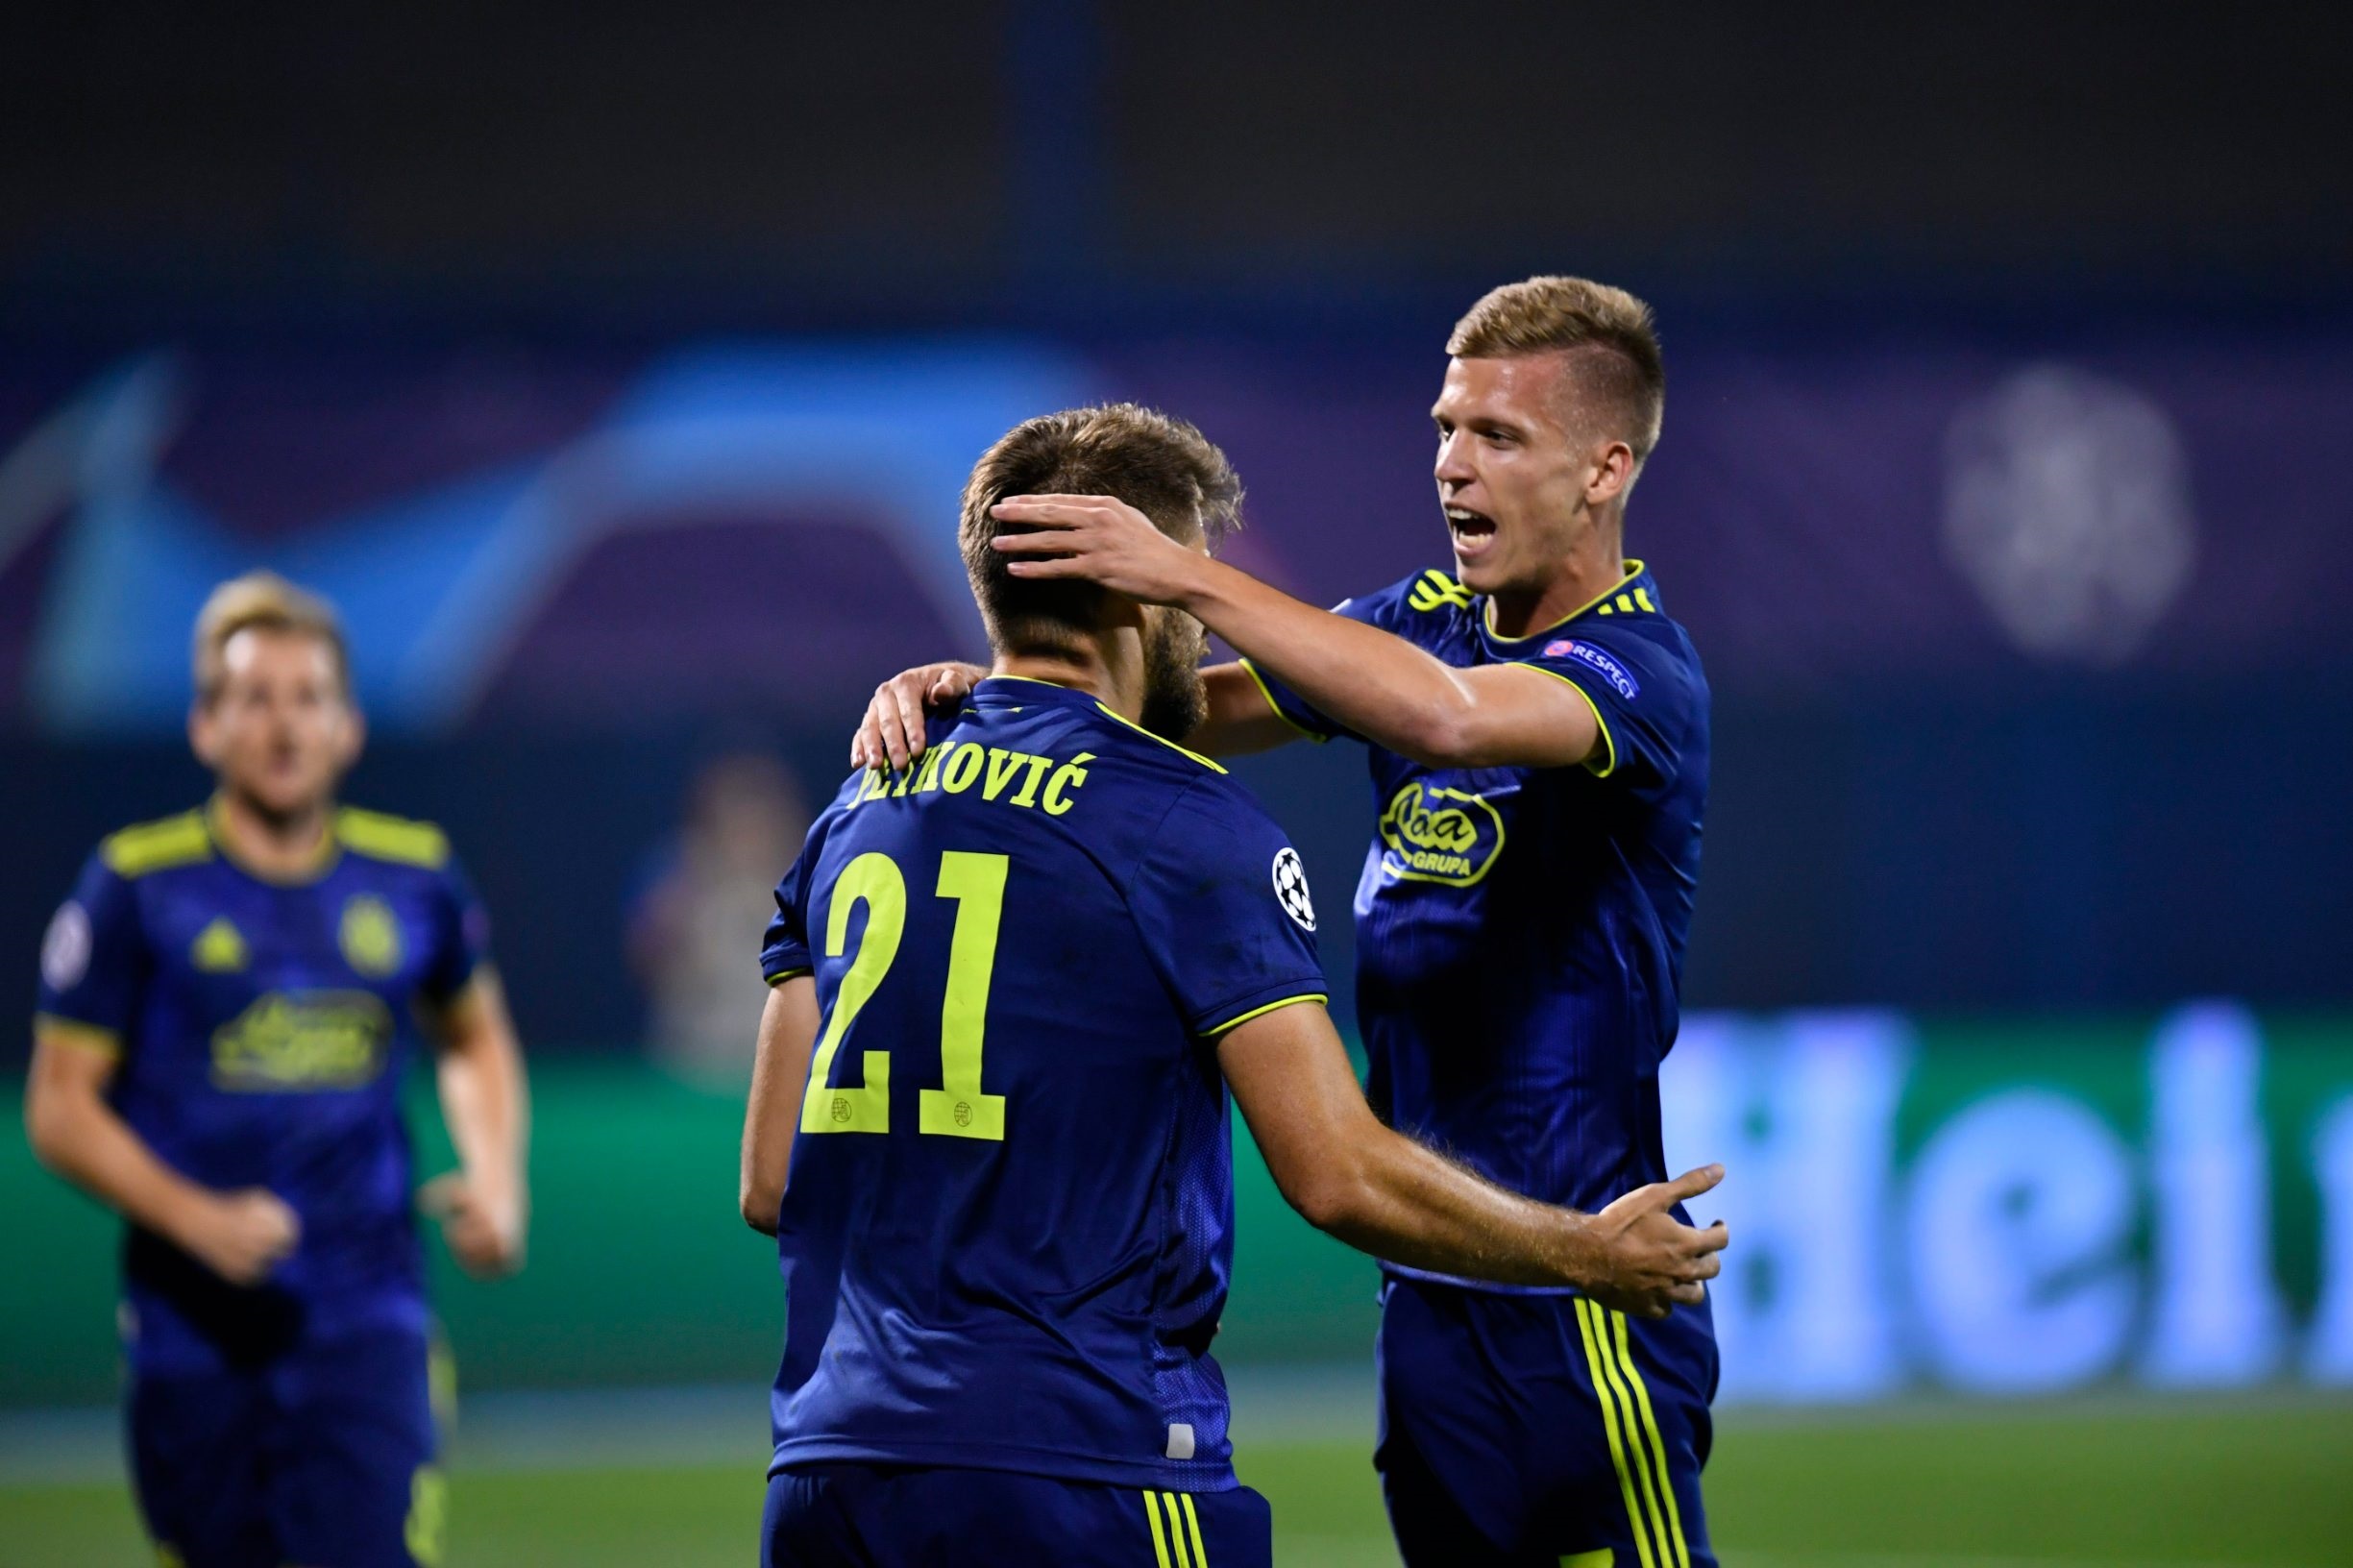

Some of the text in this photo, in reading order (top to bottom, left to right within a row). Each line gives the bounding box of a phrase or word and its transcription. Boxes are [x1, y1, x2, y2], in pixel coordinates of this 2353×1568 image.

[1572, 645, 1635, 699] RESPECT
[1412, 850, 1471, 875] GRUPA
[800, 850, 1009, 1140] 21
